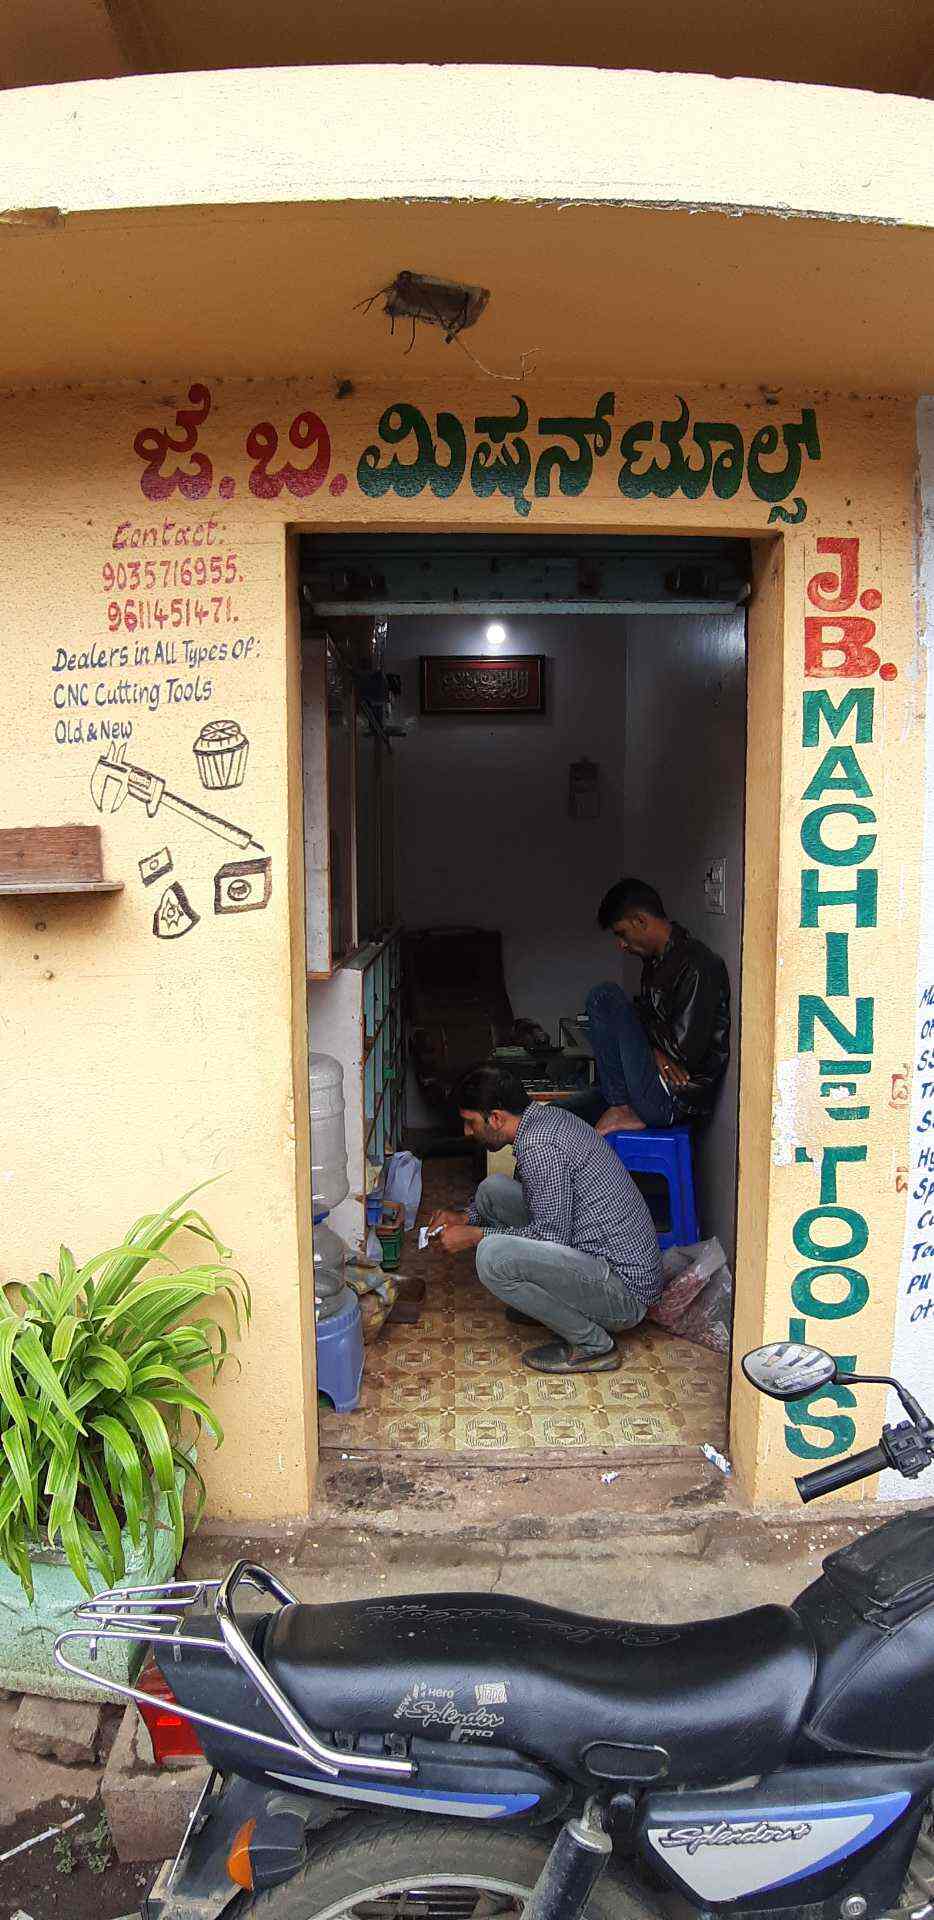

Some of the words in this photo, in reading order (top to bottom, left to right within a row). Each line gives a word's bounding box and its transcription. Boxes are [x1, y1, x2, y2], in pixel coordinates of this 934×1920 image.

[112, 518, 226, 549] Contact:
[102, 554, 244, 592] 9035716955.
[108, 596, 239, 632] 9611451471.
[51, 643, 128, 671] Dealers
[134, 641, 150, 665] in
[154, 640, 177, 665] All
[182, 640, 227, 669] Types
[53, 683, 89, 709] CNC
[94, 680, 160, 711] Cutting
[166, 675, 213, 703] Tools
[55, 719, 84, 744] Old
[87, 722, 98, 742] &
[100, 720, 133, 740] New
[405, 1700, 505, 1728] Splendor
[460, 1728, 494, 1738] PRO
